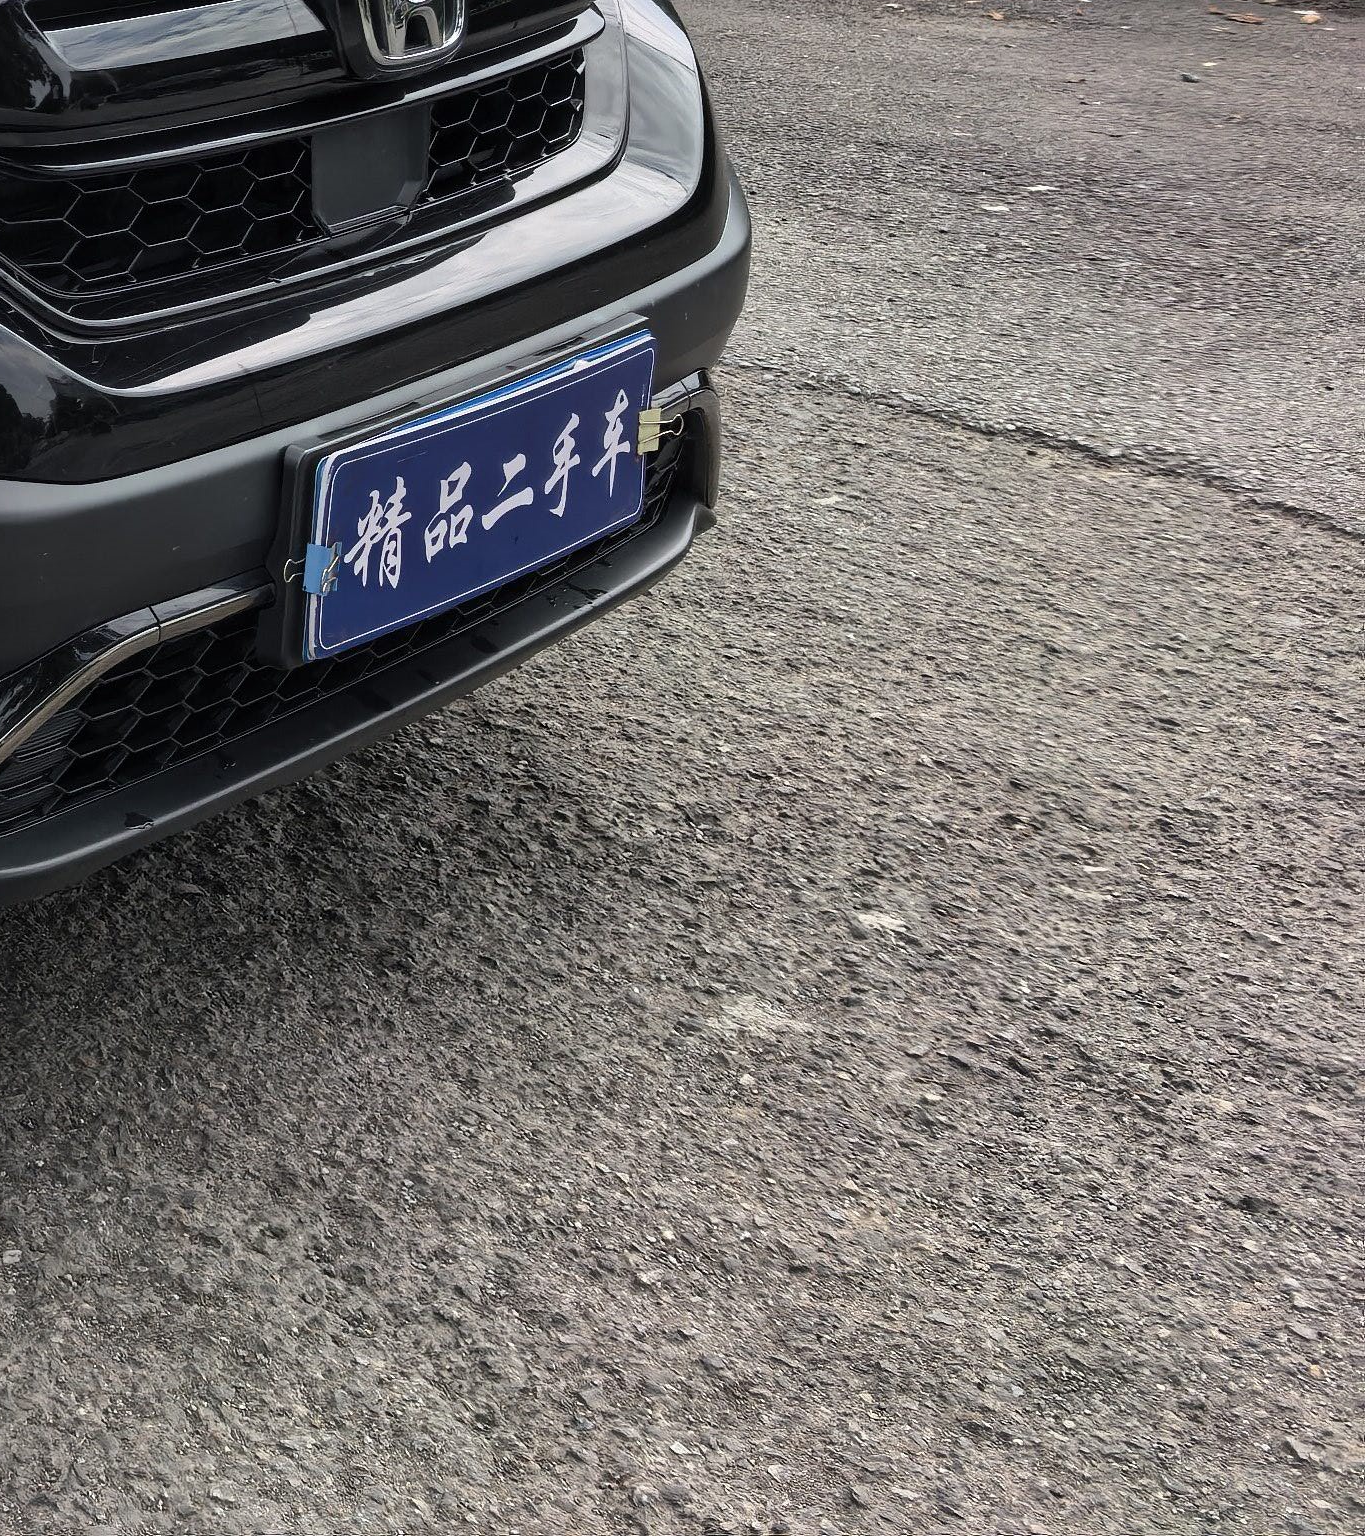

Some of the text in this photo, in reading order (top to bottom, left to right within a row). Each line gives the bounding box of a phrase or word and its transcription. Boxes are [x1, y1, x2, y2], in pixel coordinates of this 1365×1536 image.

[343, 388, 631, 590] 精品二手车
